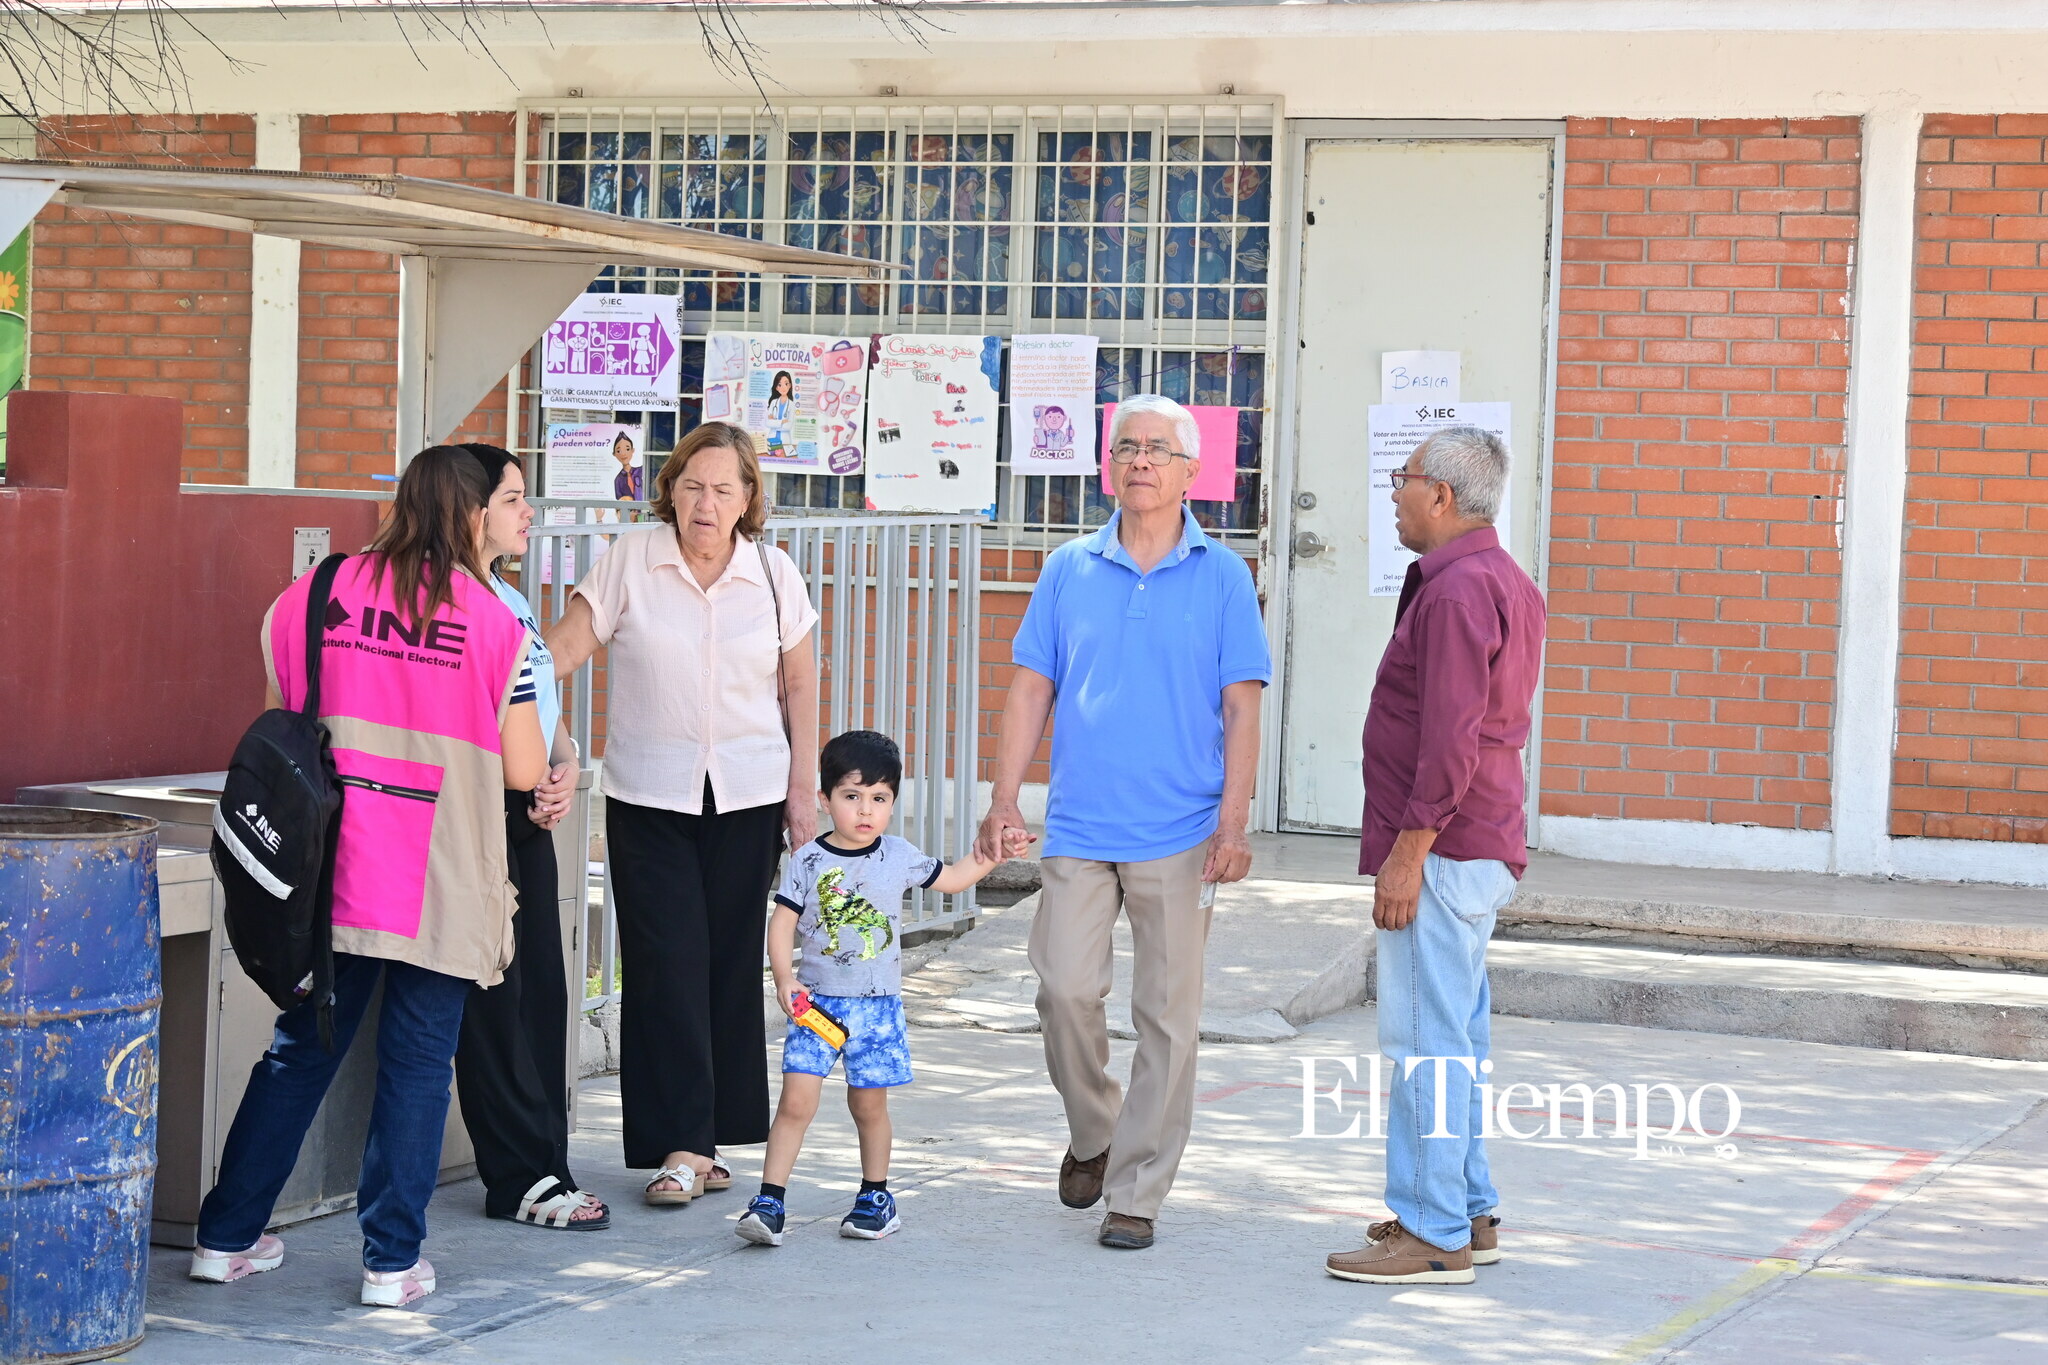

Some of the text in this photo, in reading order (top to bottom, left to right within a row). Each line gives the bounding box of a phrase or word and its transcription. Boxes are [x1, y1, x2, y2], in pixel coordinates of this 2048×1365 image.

[608, 298, 622, 306] IEC
[1049, 340, 1074, 350] doctor
[765, 350, 811, 364] DOCTORA
[1391, 366, 1449, 391] BASICA
[576, 389, 612, 397] GARANTIZA
[623, 390, 658, 398] INCLUSIÓN
[550, 396, 599, 405] GARANTICEMOS
[1434, 408, 1456, 419] IEC
[552, 438, 611, 448] pueden votar?
[1031, 448, 1074, 459] DOCTOR
[360, 606, 467, 655] INE
[321, 638, 461, 671] tituto Nacional Electoral
[255, 815, 282, 850] INE
